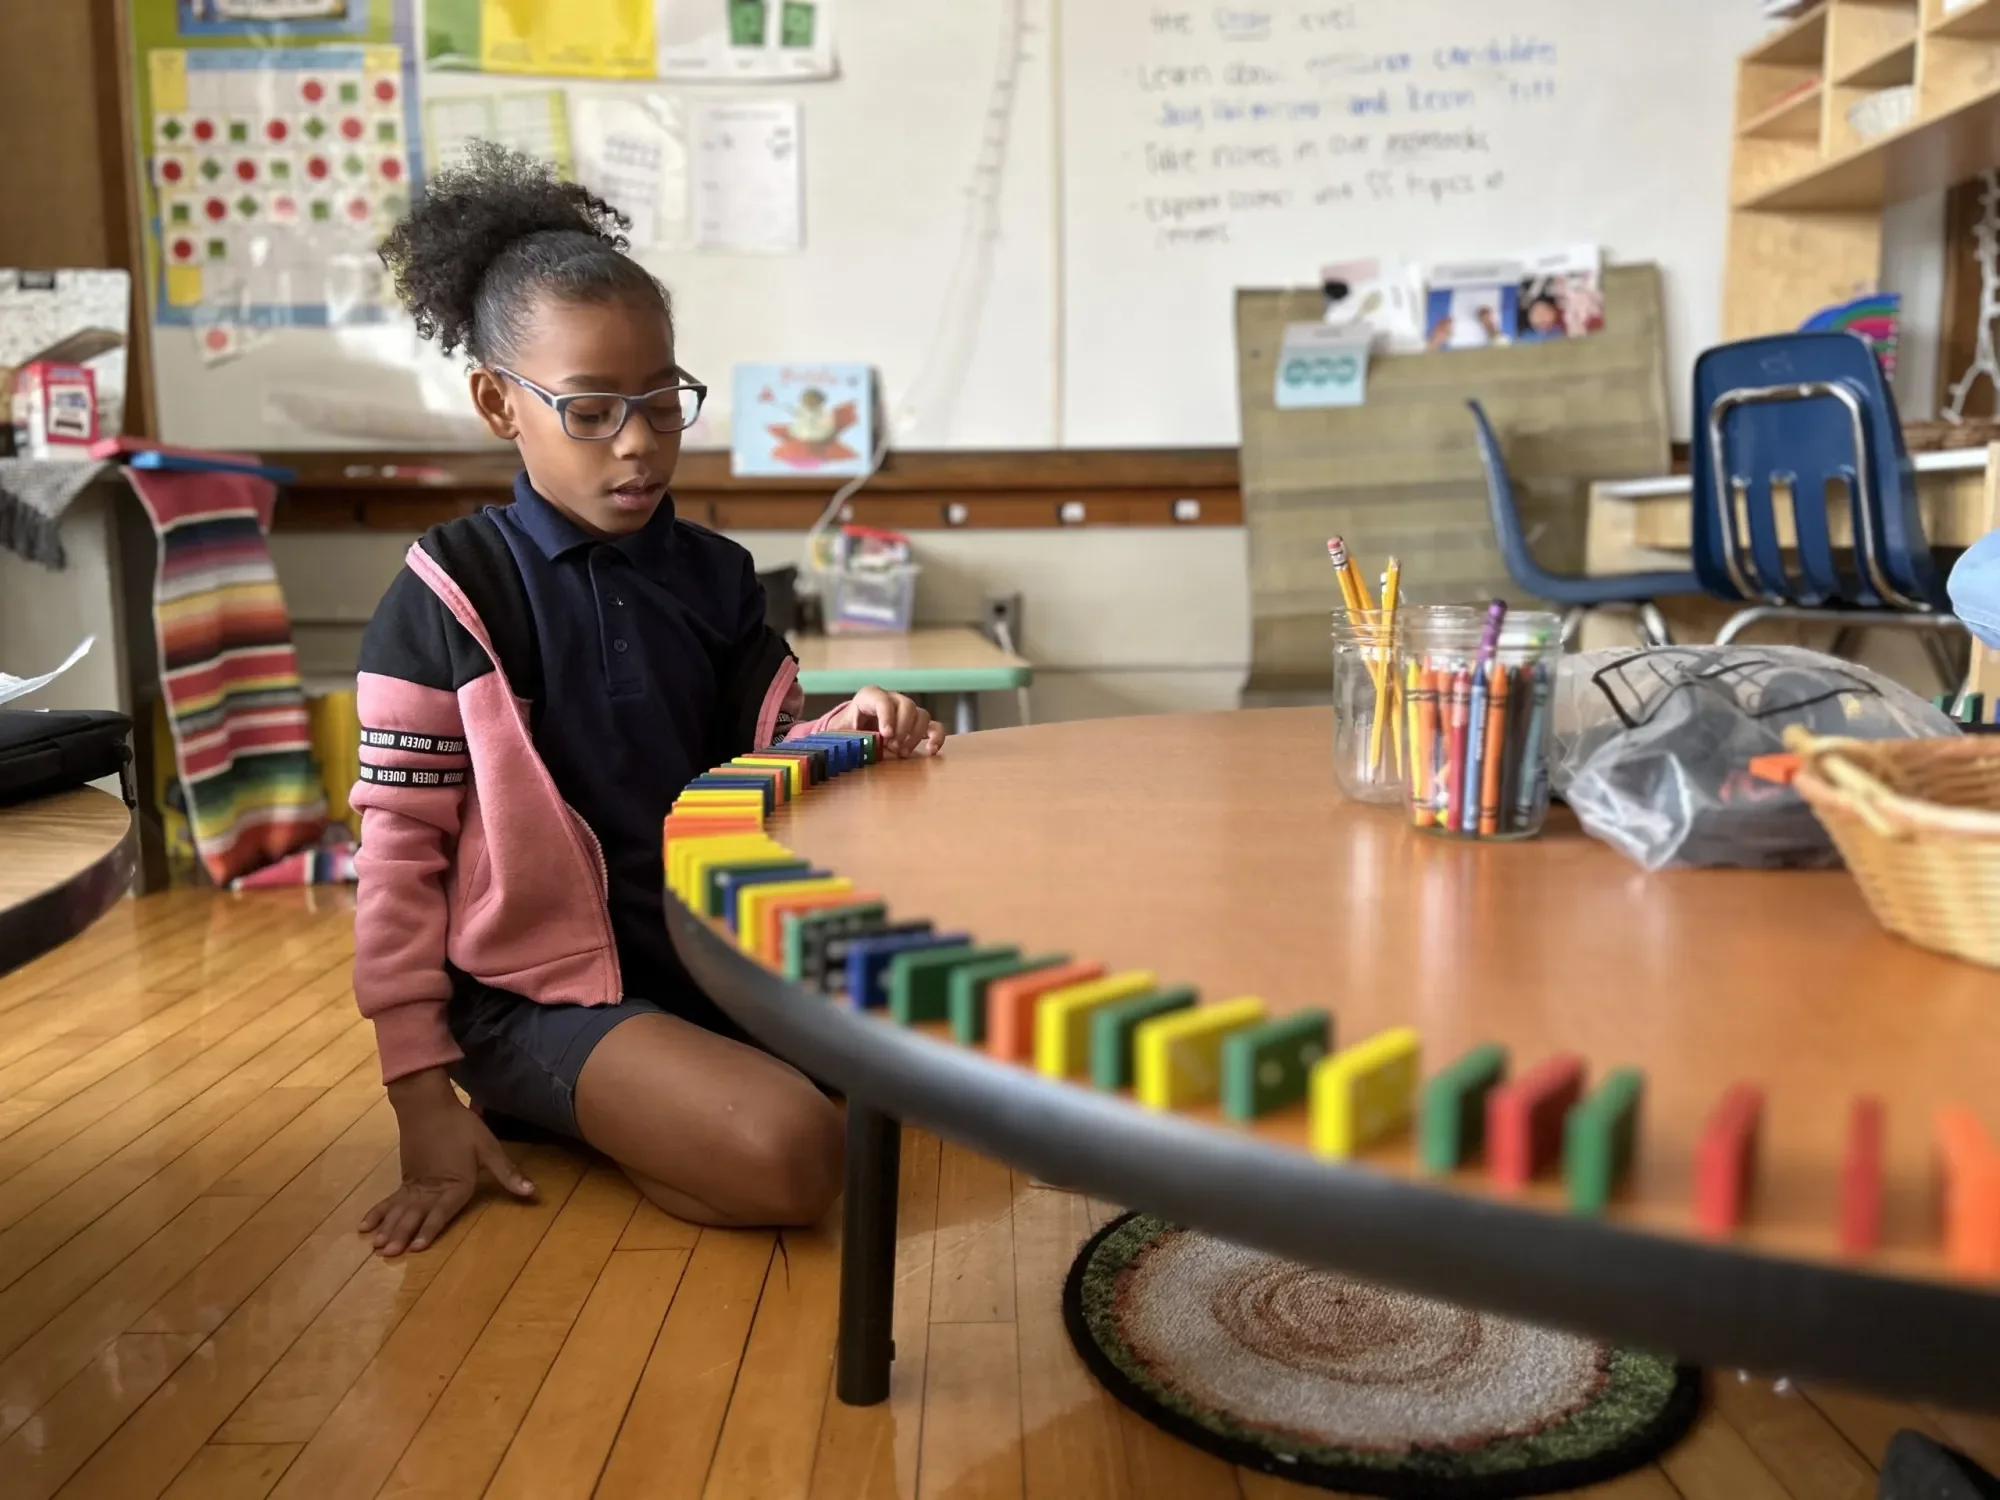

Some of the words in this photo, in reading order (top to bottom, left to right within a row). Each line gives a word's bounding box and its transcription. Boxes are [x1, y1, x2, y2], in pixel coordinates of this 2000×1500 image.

[370, 731, 395, 746] QUEEN
[400, 735, 432, 750] QUEEN
[437, 740, 463, 752] QUEEN
[377, 769, 407, 782] QUEEN
[412, 772, 439, 784] QUEEN
